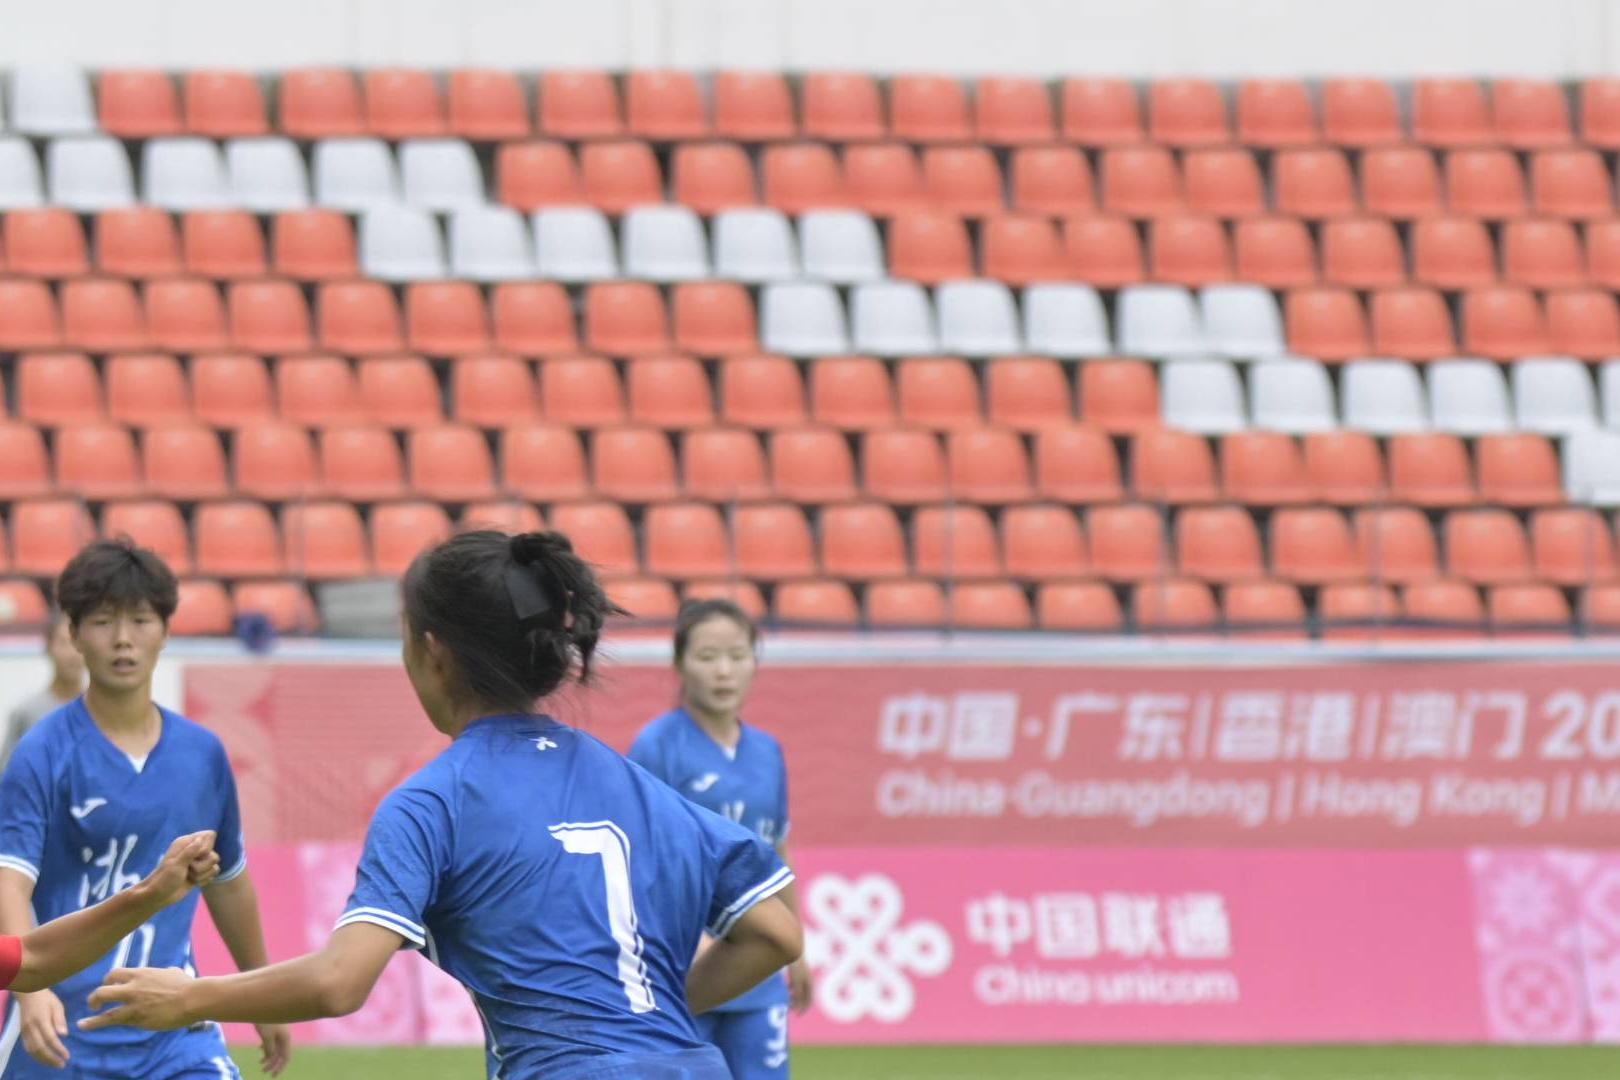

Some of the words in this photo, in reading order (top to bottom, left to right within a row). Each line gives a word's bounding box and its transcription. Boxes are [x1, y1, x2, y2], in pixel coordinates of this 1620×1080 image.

[547, 820, 660, 1014] 7
[966, 890, 1232, 958] 中国联通
[973, 963, 1091, 1005] China
